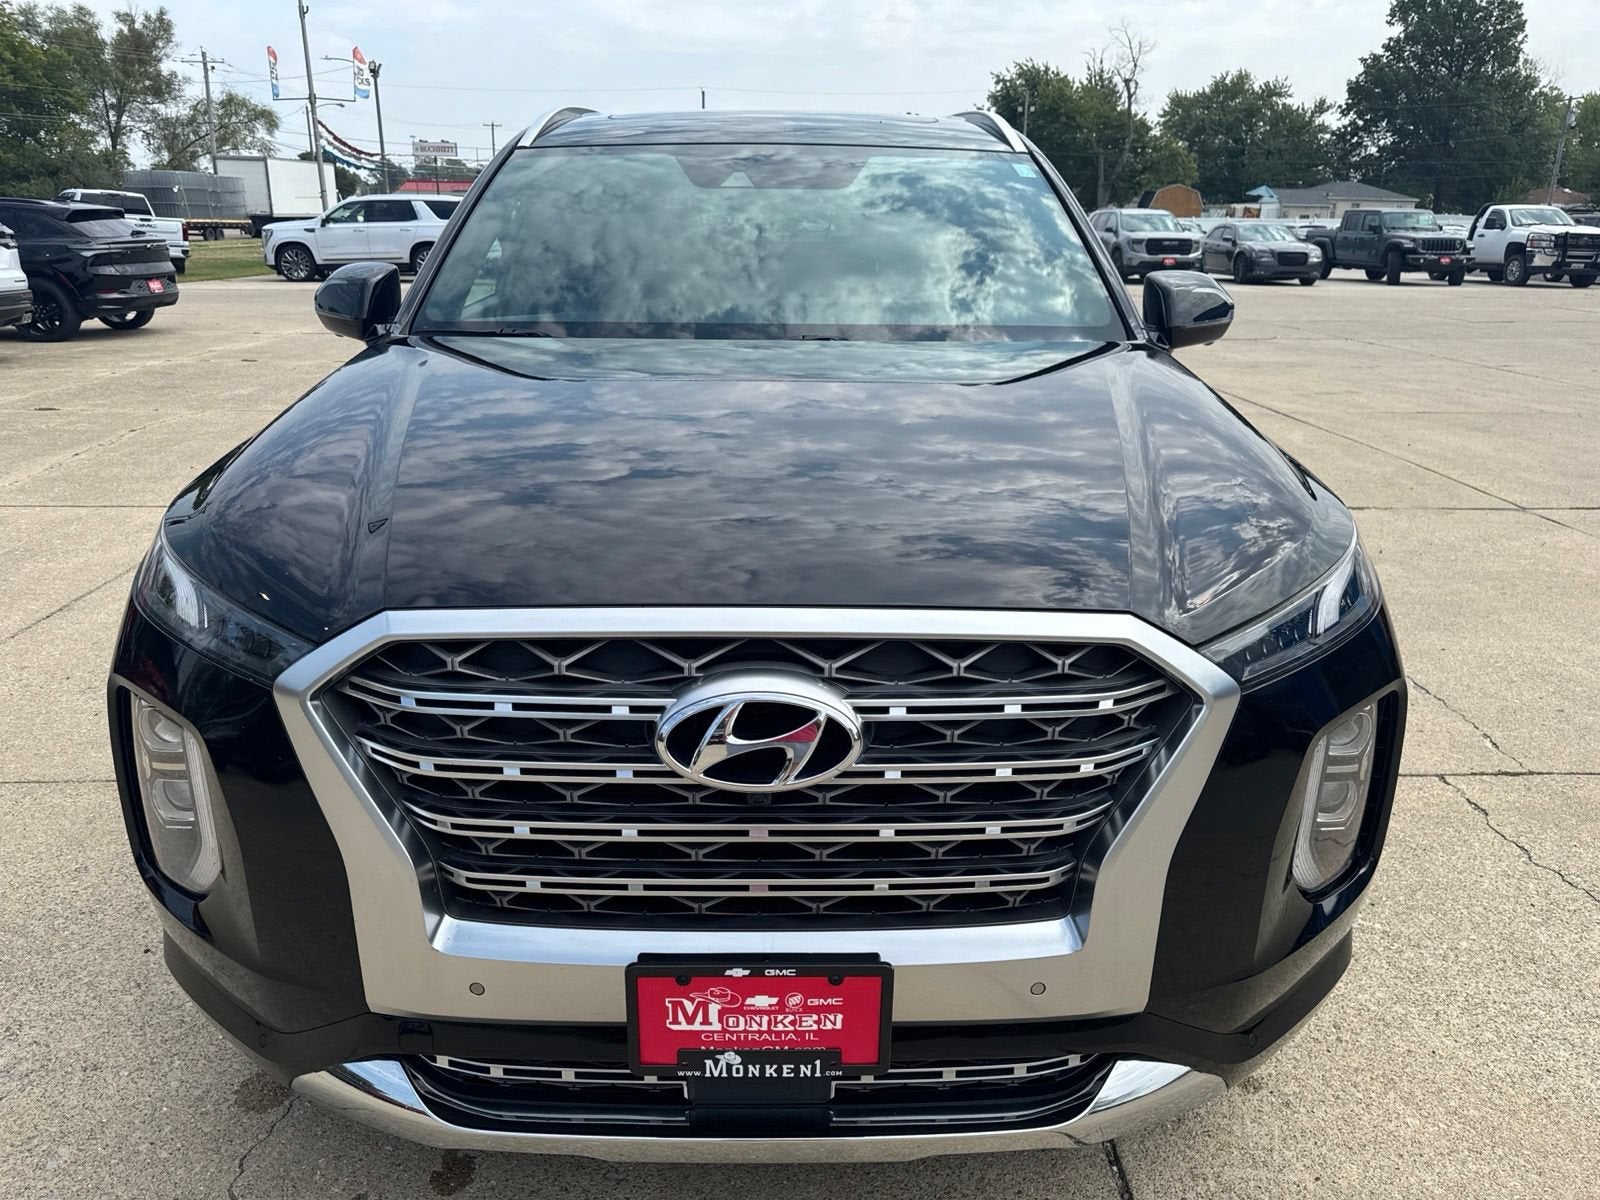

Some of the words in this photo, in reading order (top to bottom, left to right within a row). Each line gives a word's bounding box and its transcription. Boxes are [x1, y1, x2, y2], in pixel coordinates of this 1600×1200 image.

[807, 998, 843, 1006] GMC
[666, 997, 844, 1031] MONKEN
[701, 1032, 801, 1042] CENTRALIA,
[805, 1032, 819, 1041] IL
